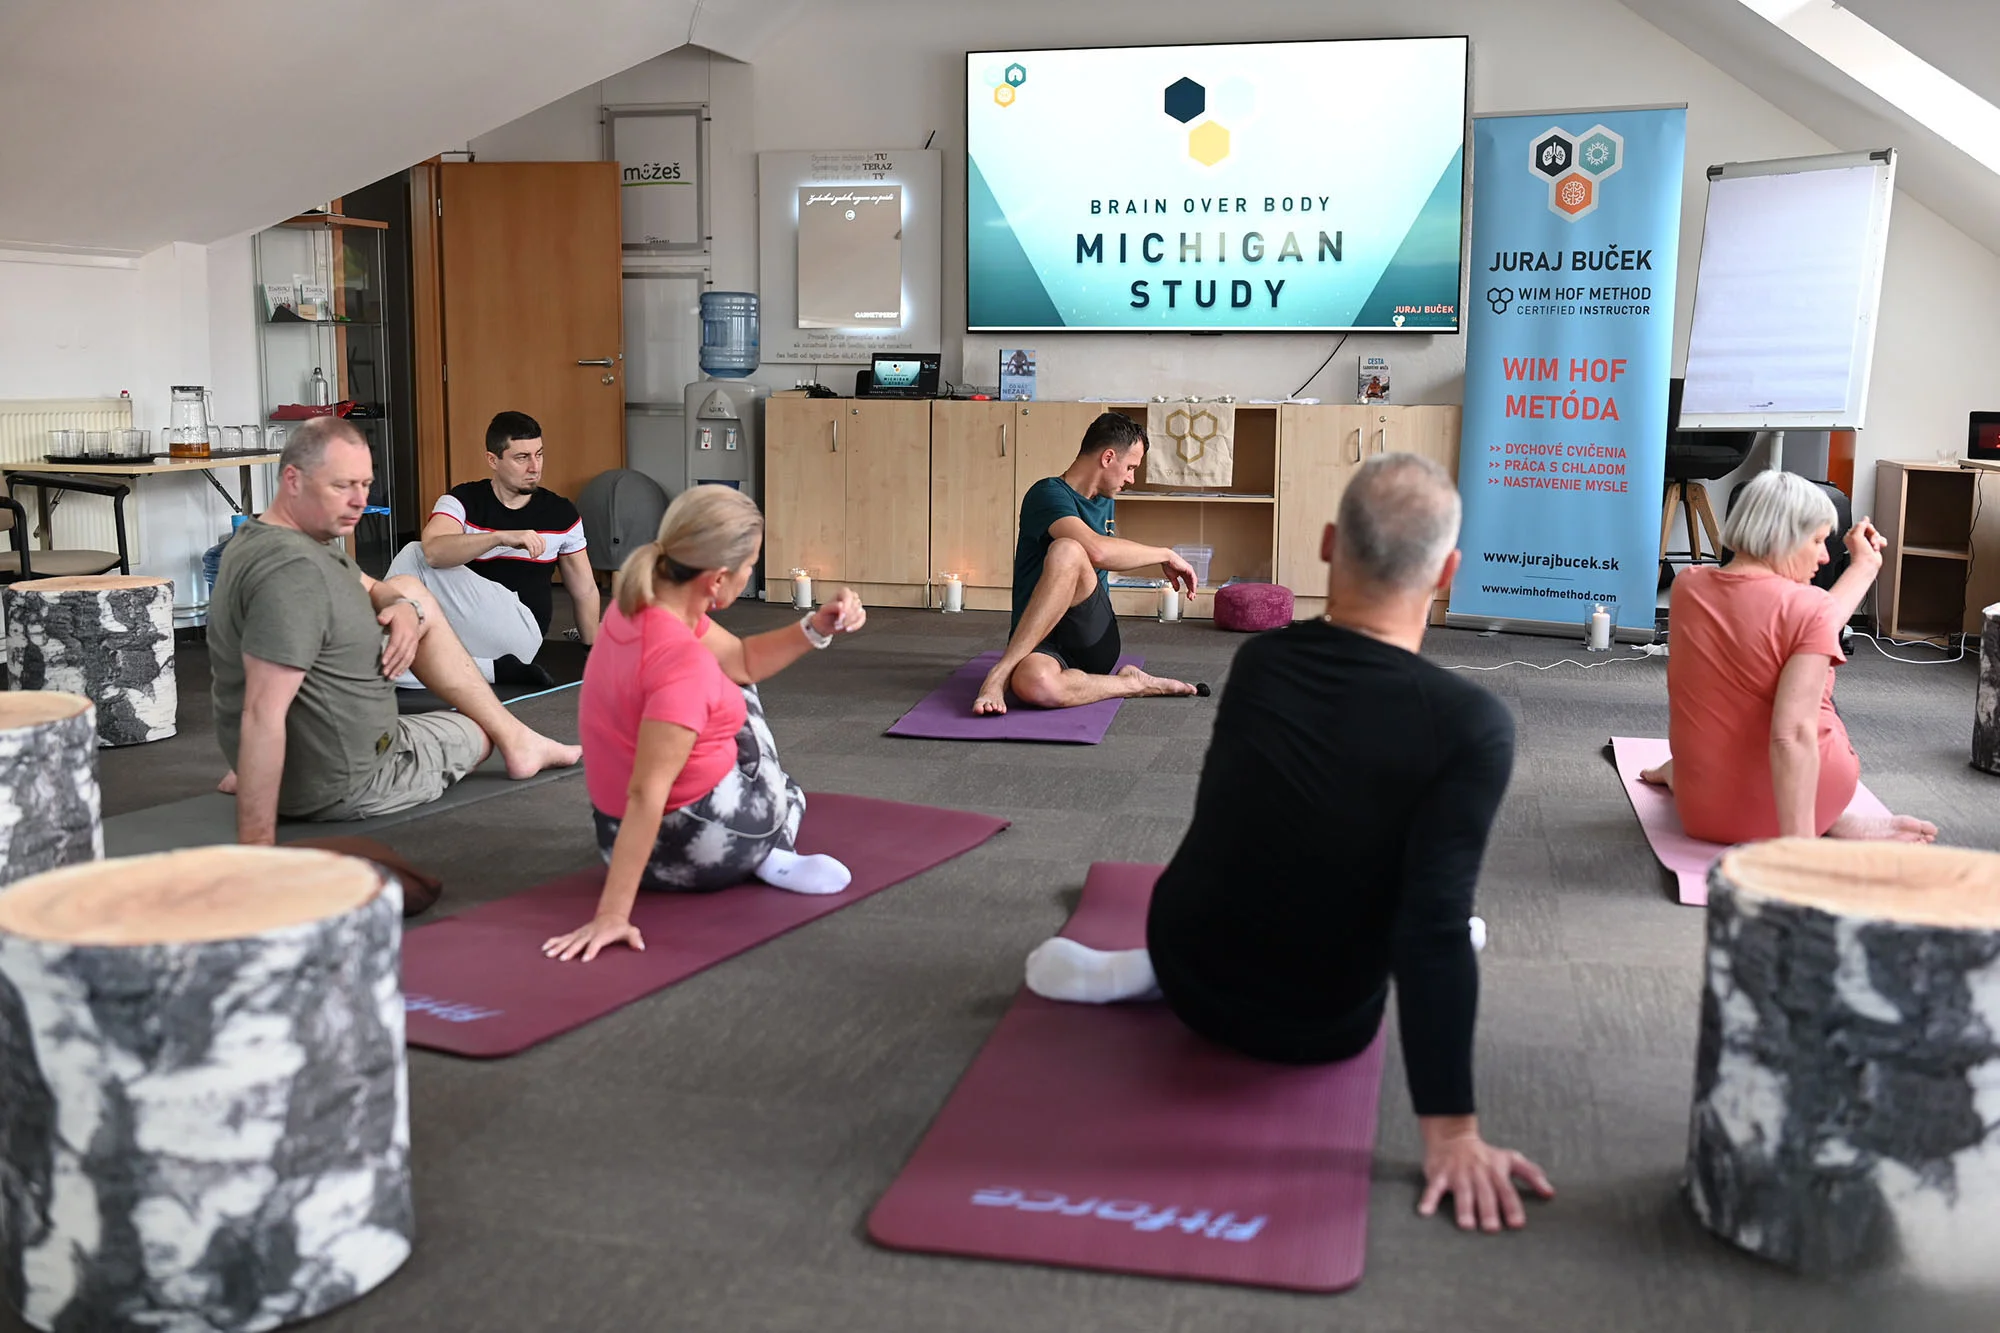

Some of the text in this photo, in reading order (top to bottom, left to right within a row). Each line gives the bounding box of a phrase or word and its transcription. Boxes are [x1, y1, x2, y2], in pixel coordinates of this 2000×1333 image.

[874, 153, 888, 161] TU
[862, 163, 892, 171] TERAZ
[1091, 196, 1329, 215] BRAIN OVER BODY
[1076, 231, 1343, 263] MICHIGAN
[1489, 244, 1653, 272] JURAJ BUČEK
[1130, 279, 1286, 309] STUDY
[1518, 286, 1652, 301] WIM HOF METHOD
[1393, 303, 1454, 314] JURAJ BUČEK
[1517, 305, 1650, 315] CERTIFIED INSTRUCTOR
[1503, 357, 1627, 383] WIM HOF
[1505, 389, 1620, 421] METÓDA
[1505, 442, 1627, 459] DYCHOVÉ CVIČENIA
[1504, 457, 1625, 475] PRÁCA S CHLADOM
[1503, 476, 1629, 493] NASTAVENIE MYSLE
[1483, 552, 1620, 571] www.jurajbucek.sk
[1482, 584, 1617, 602] www.wimhofmethod.com
